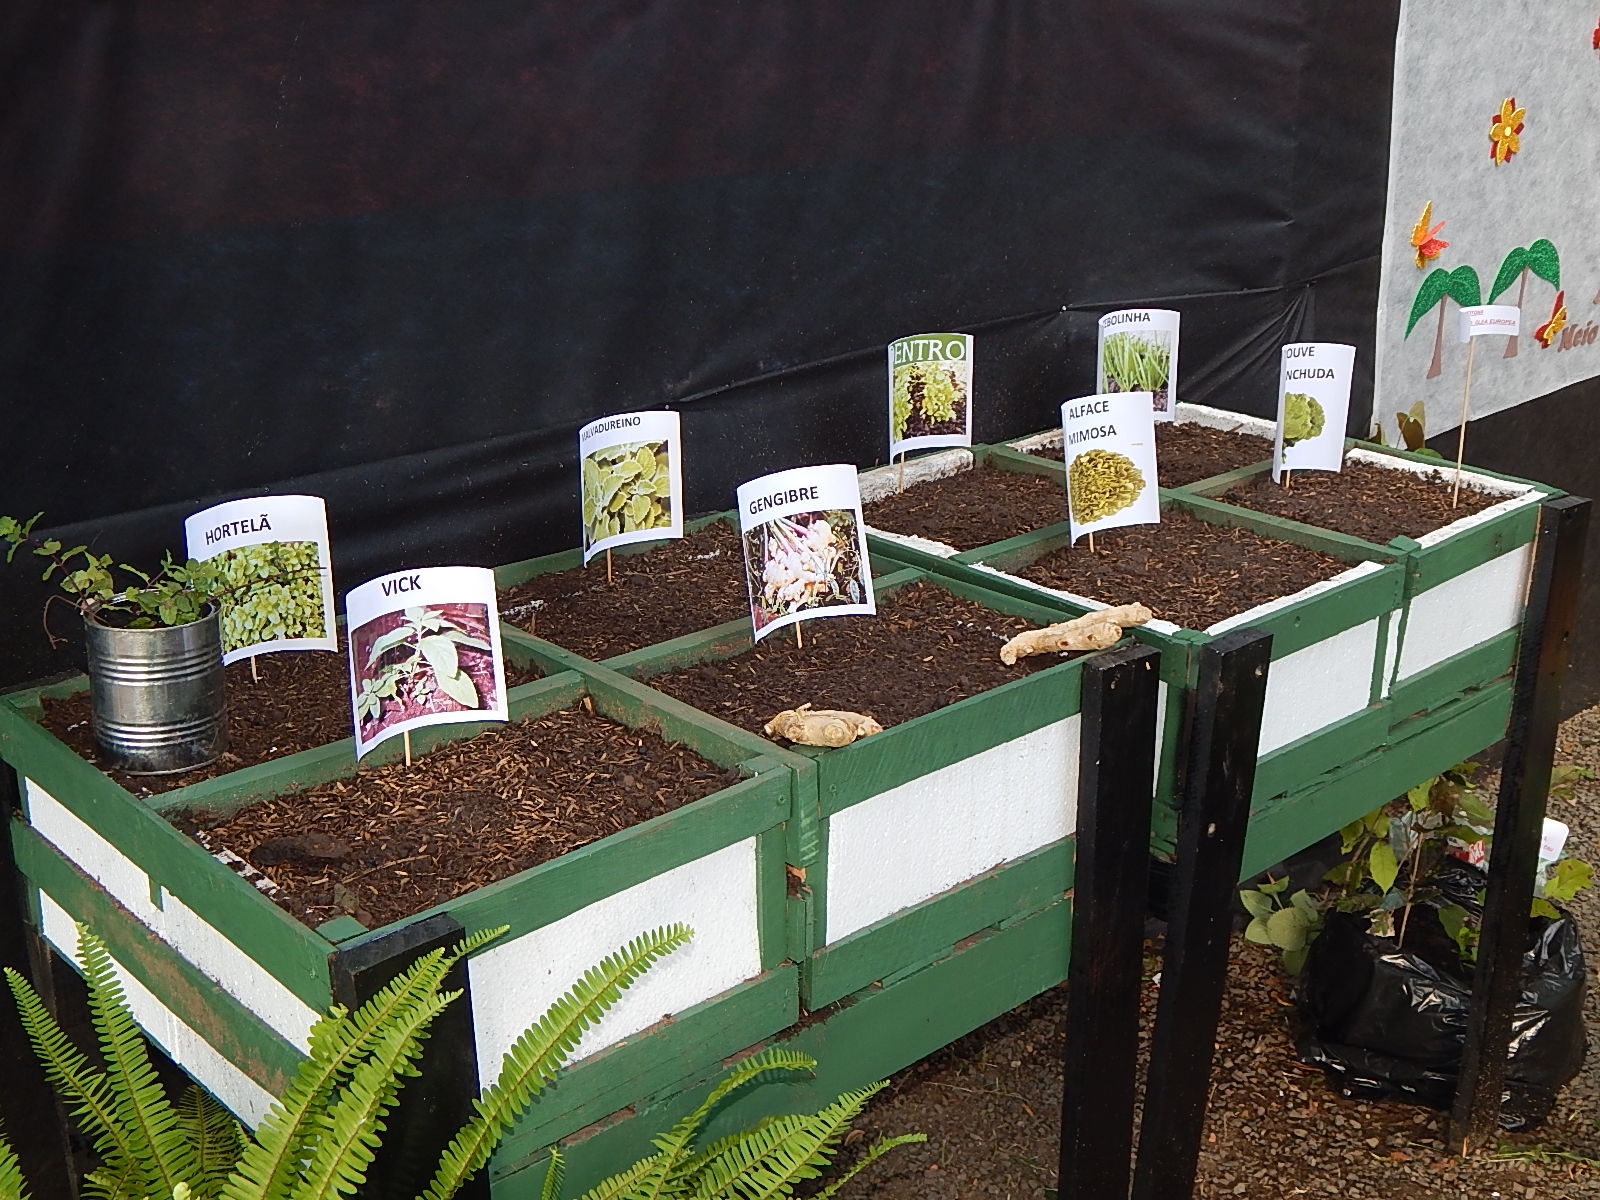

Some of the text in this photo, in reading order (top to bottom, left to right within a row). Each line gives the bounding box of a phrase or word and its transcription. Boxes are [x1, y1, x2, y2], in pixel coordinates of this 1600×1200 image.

[1102, 312, 1151, 328] EBOLINHA
[1285, 346, 1316, 359] OUVE
[1069, 400, 1110, 420] ALFACE
[1068, 424, 1117, 446] MIMOSA
[749, 485, 819, 515] GENGIBRE
[205, 513, 272, 546] HORTELÃ
[381, 574, 422, 597] VICK
